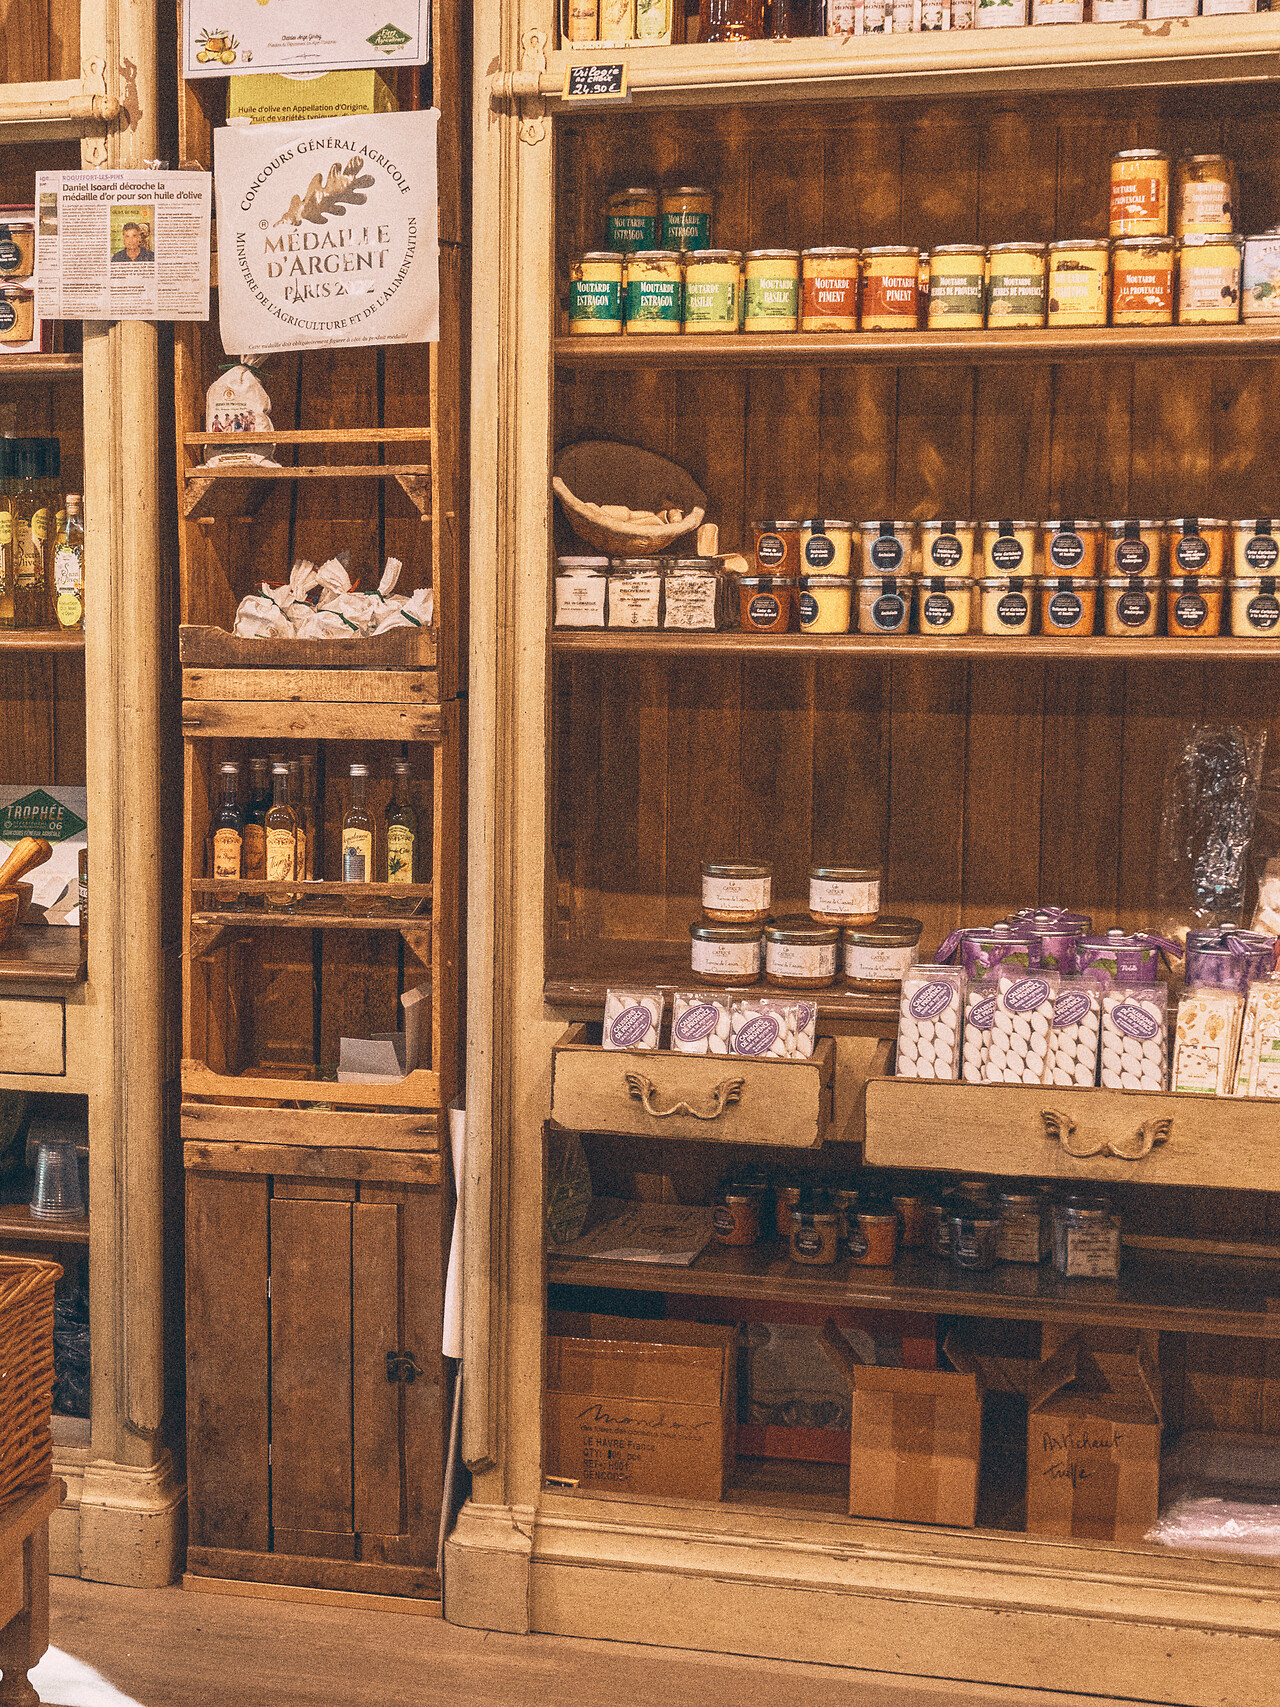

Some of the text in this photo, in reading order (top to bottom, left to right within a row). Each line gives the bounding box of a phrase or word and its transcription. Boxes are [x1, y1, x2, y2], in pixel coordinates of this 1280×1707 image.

[293, 105, 333, 113] Appellation
[240, 136, 411, 211] CONCOURS GÉNÉRAL AGRICOLE
[62, 182, 165, 192] Daniel Isoardi décroche la
[62, 193, 98, 201] médaille
[99, 192, 115, 201] d'or
[116, 194, 135, 202] pour
[154, 192, 174, 200] huile
[176, 191, 202, 200] d'olive
[255, 291, 269, 307] DE
[267, 302, 348, 331] L'AGRICULTURE
[363, 304, 378, 319] DE
[377, 216, 417, 307] L'ALIMENTATION
[267, 249, 390, 279] D'ARGENT
[577, 282, 610, 293] MOUTARDE
[640, 282, 674, 293] MOUTARDE
[815, 277, 850, 289] MOUTARDE
[882, 276, 916, 288] MOUTARDE
[577, 295, 609, 306] ESTRAGON
[640, 295, 673, 306] ESTRAGON
[818, 291, 845, 303] PIMENT
[886, 290, 912, 302] PIMENT
[7, 803, 65, 816] TROPHÉE
[49, 821, 63, 830] 06
[913, 982, 937, 1008] CALISSONS
[922, 985, 944, 1007] PROVENCE
[1008, 980, 1034, 999] CALISSONS
[1016, 982, 1041, 1001] PROVENCE
[613, 1009, 637, 1034] CALISSONS
[622, 1011, 644, 1033] PROVENCE
[679, 1005, 704, 1029] CALISSONS
[689, 1007, 712, 1029] PROVENCE
[1126, 1012, 1154, 1031] PROVENCE
[1127, 1006, 1154, 1027] CALISSONS
[739, 1017, 764, 1042] CALISSONS
[747, 1020, 771, 1042] PROVENCE
[596, 1439, 626, 1449] HAVRE
